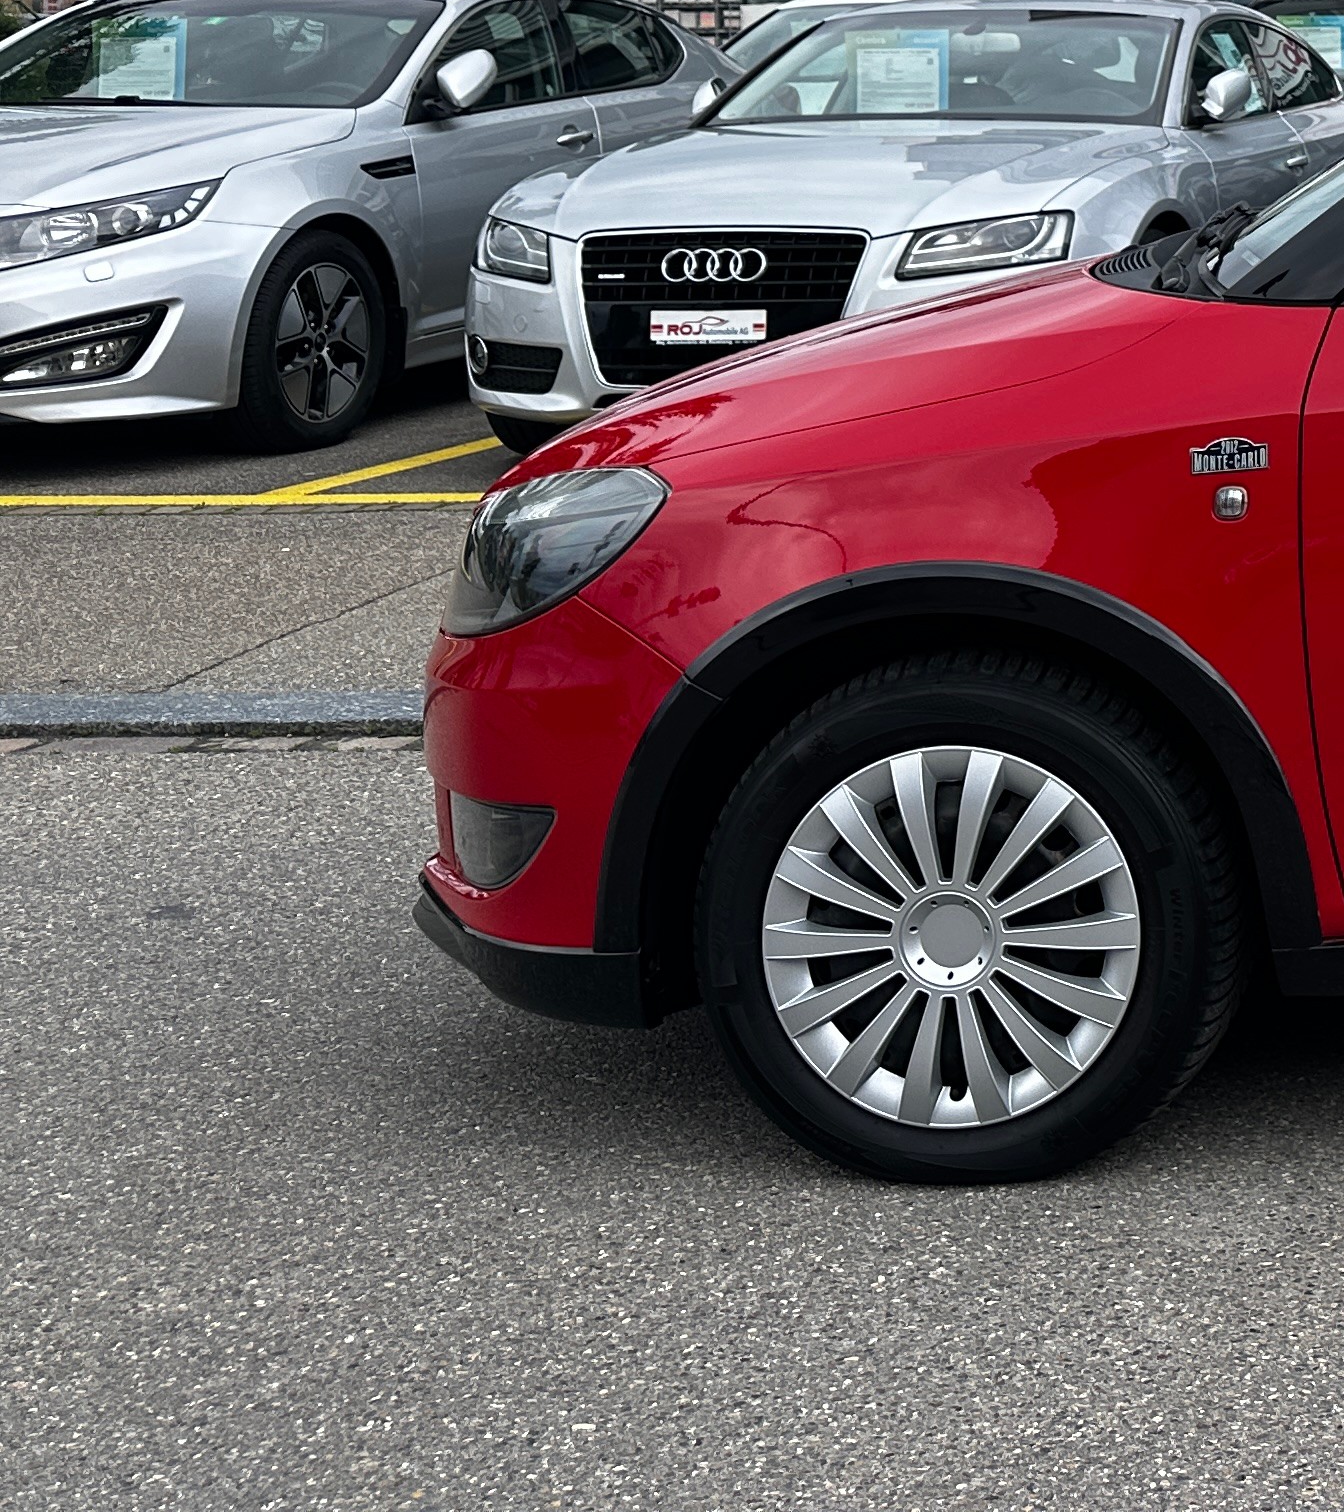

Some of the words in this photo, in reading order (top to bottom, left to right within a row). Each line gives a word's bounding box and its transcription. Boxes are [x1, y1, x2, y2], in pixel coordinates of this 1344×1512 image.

[667, 324, 703, 336] ROJ
[703, 327, 738, 335] Automobile
[1221, 440, 1239, 454] 2012
[1193, 447, 1266, 472] MONTE-CARLO
